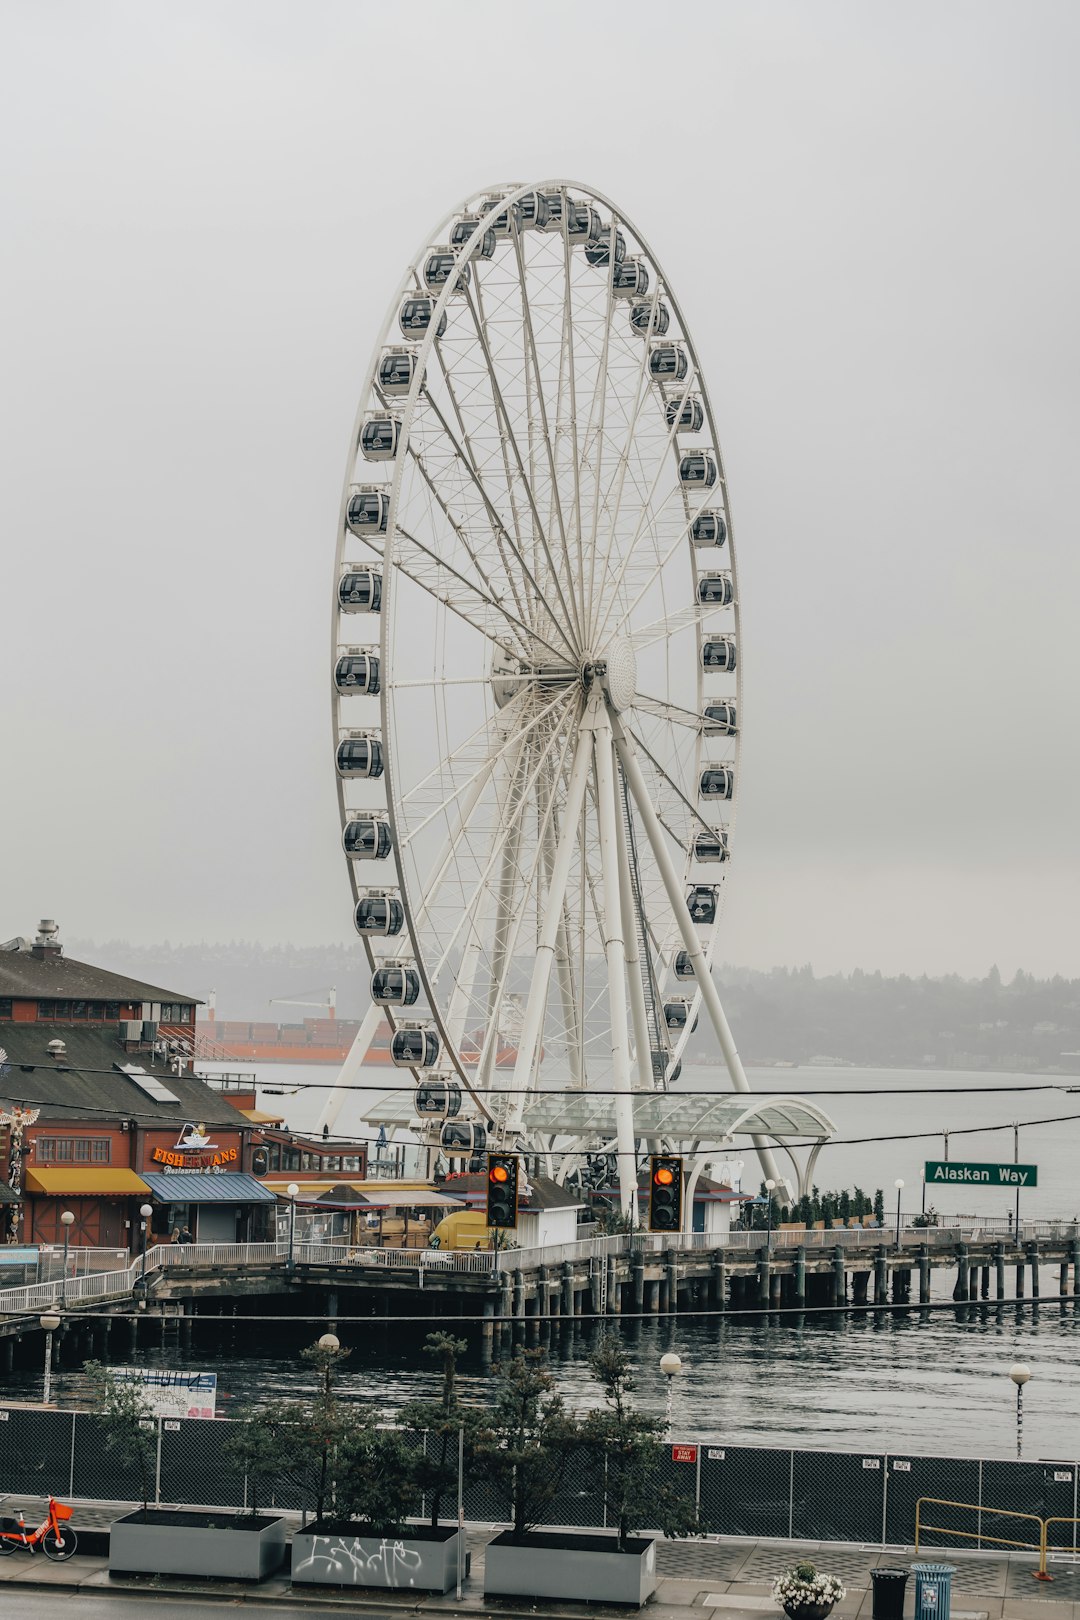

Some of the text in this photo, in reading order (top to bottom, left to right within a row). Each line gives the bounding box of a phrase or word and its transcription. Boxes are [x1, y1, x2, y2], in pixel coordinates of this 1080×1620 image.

[153, 1147, 237, 1167] FISHERMANS
[163, 1165, 227, 1175] Restaurant & Bar
[934, 1166, 1028, 1185] Alaskan Way
